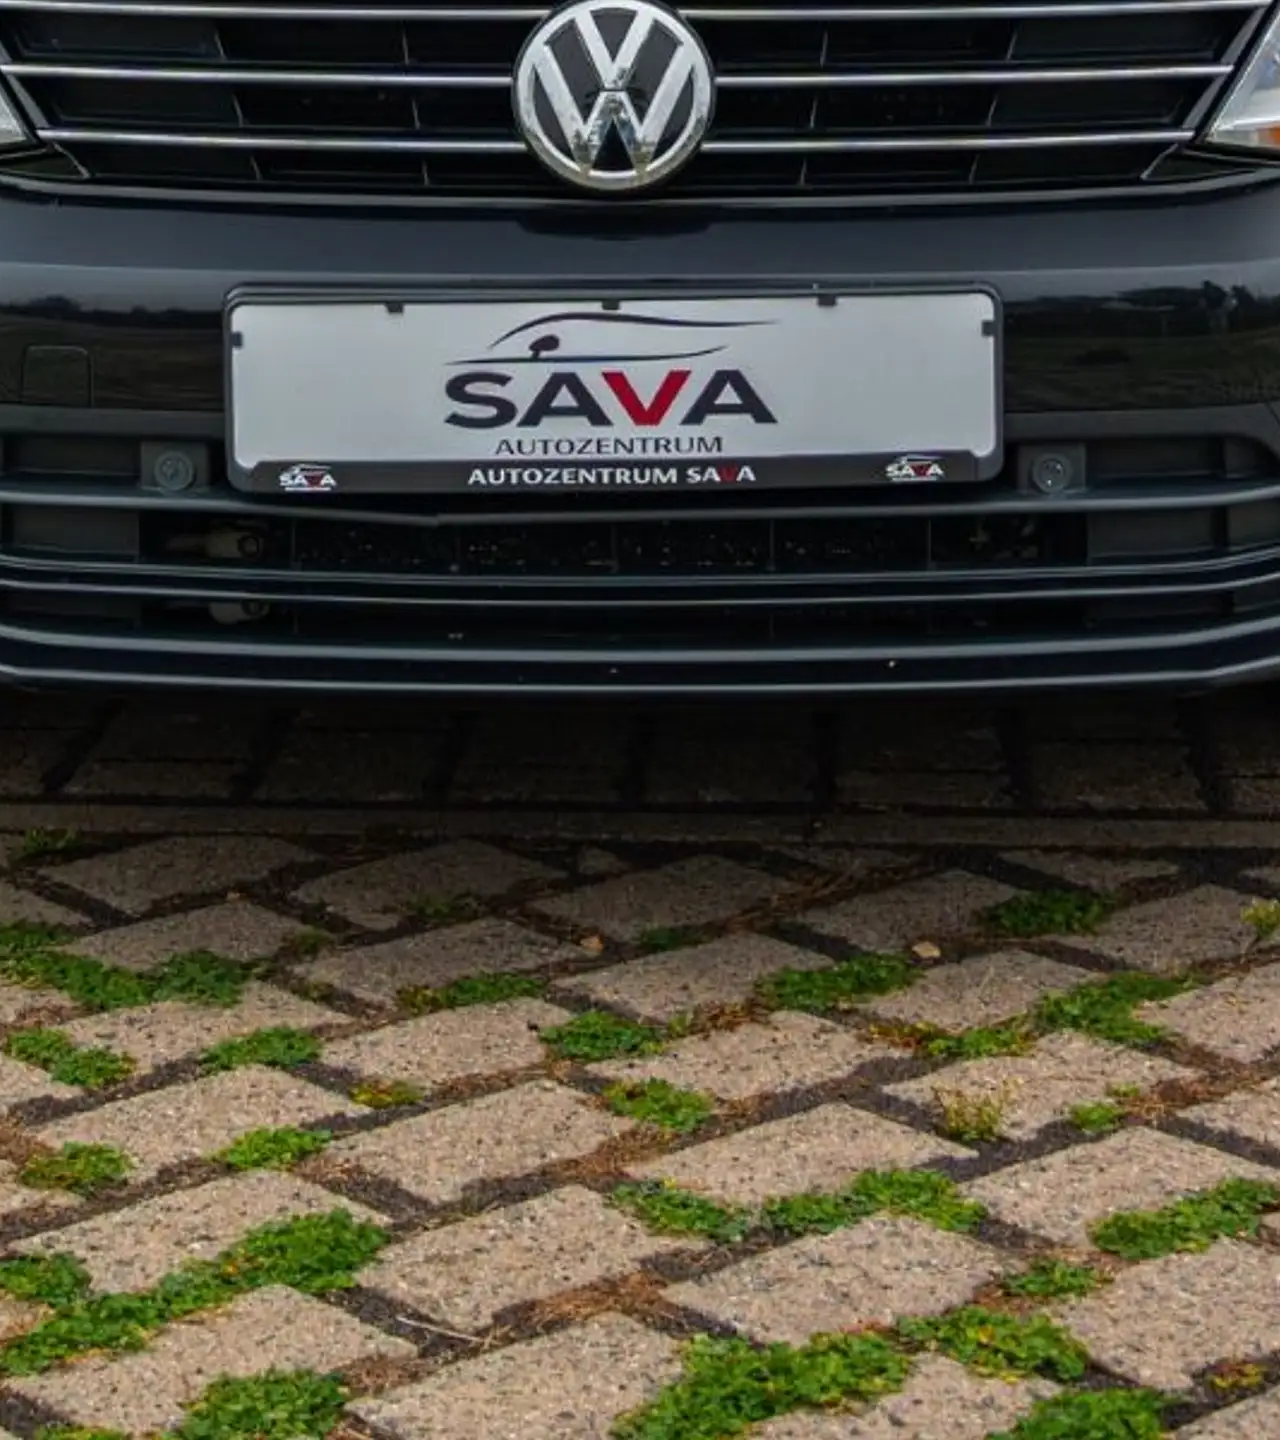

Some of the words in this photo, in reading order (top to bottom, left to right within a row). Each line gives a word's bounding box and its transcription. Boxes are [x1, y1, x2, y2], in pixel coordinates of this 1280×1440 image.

[444, 369, 779, 429] SAVA
[495, 436, 723, 455] AUTOZENTRUM
[468, 467, 677, 485] AUTOZENTRUM
[686, 465, 756, 484] SAVA
